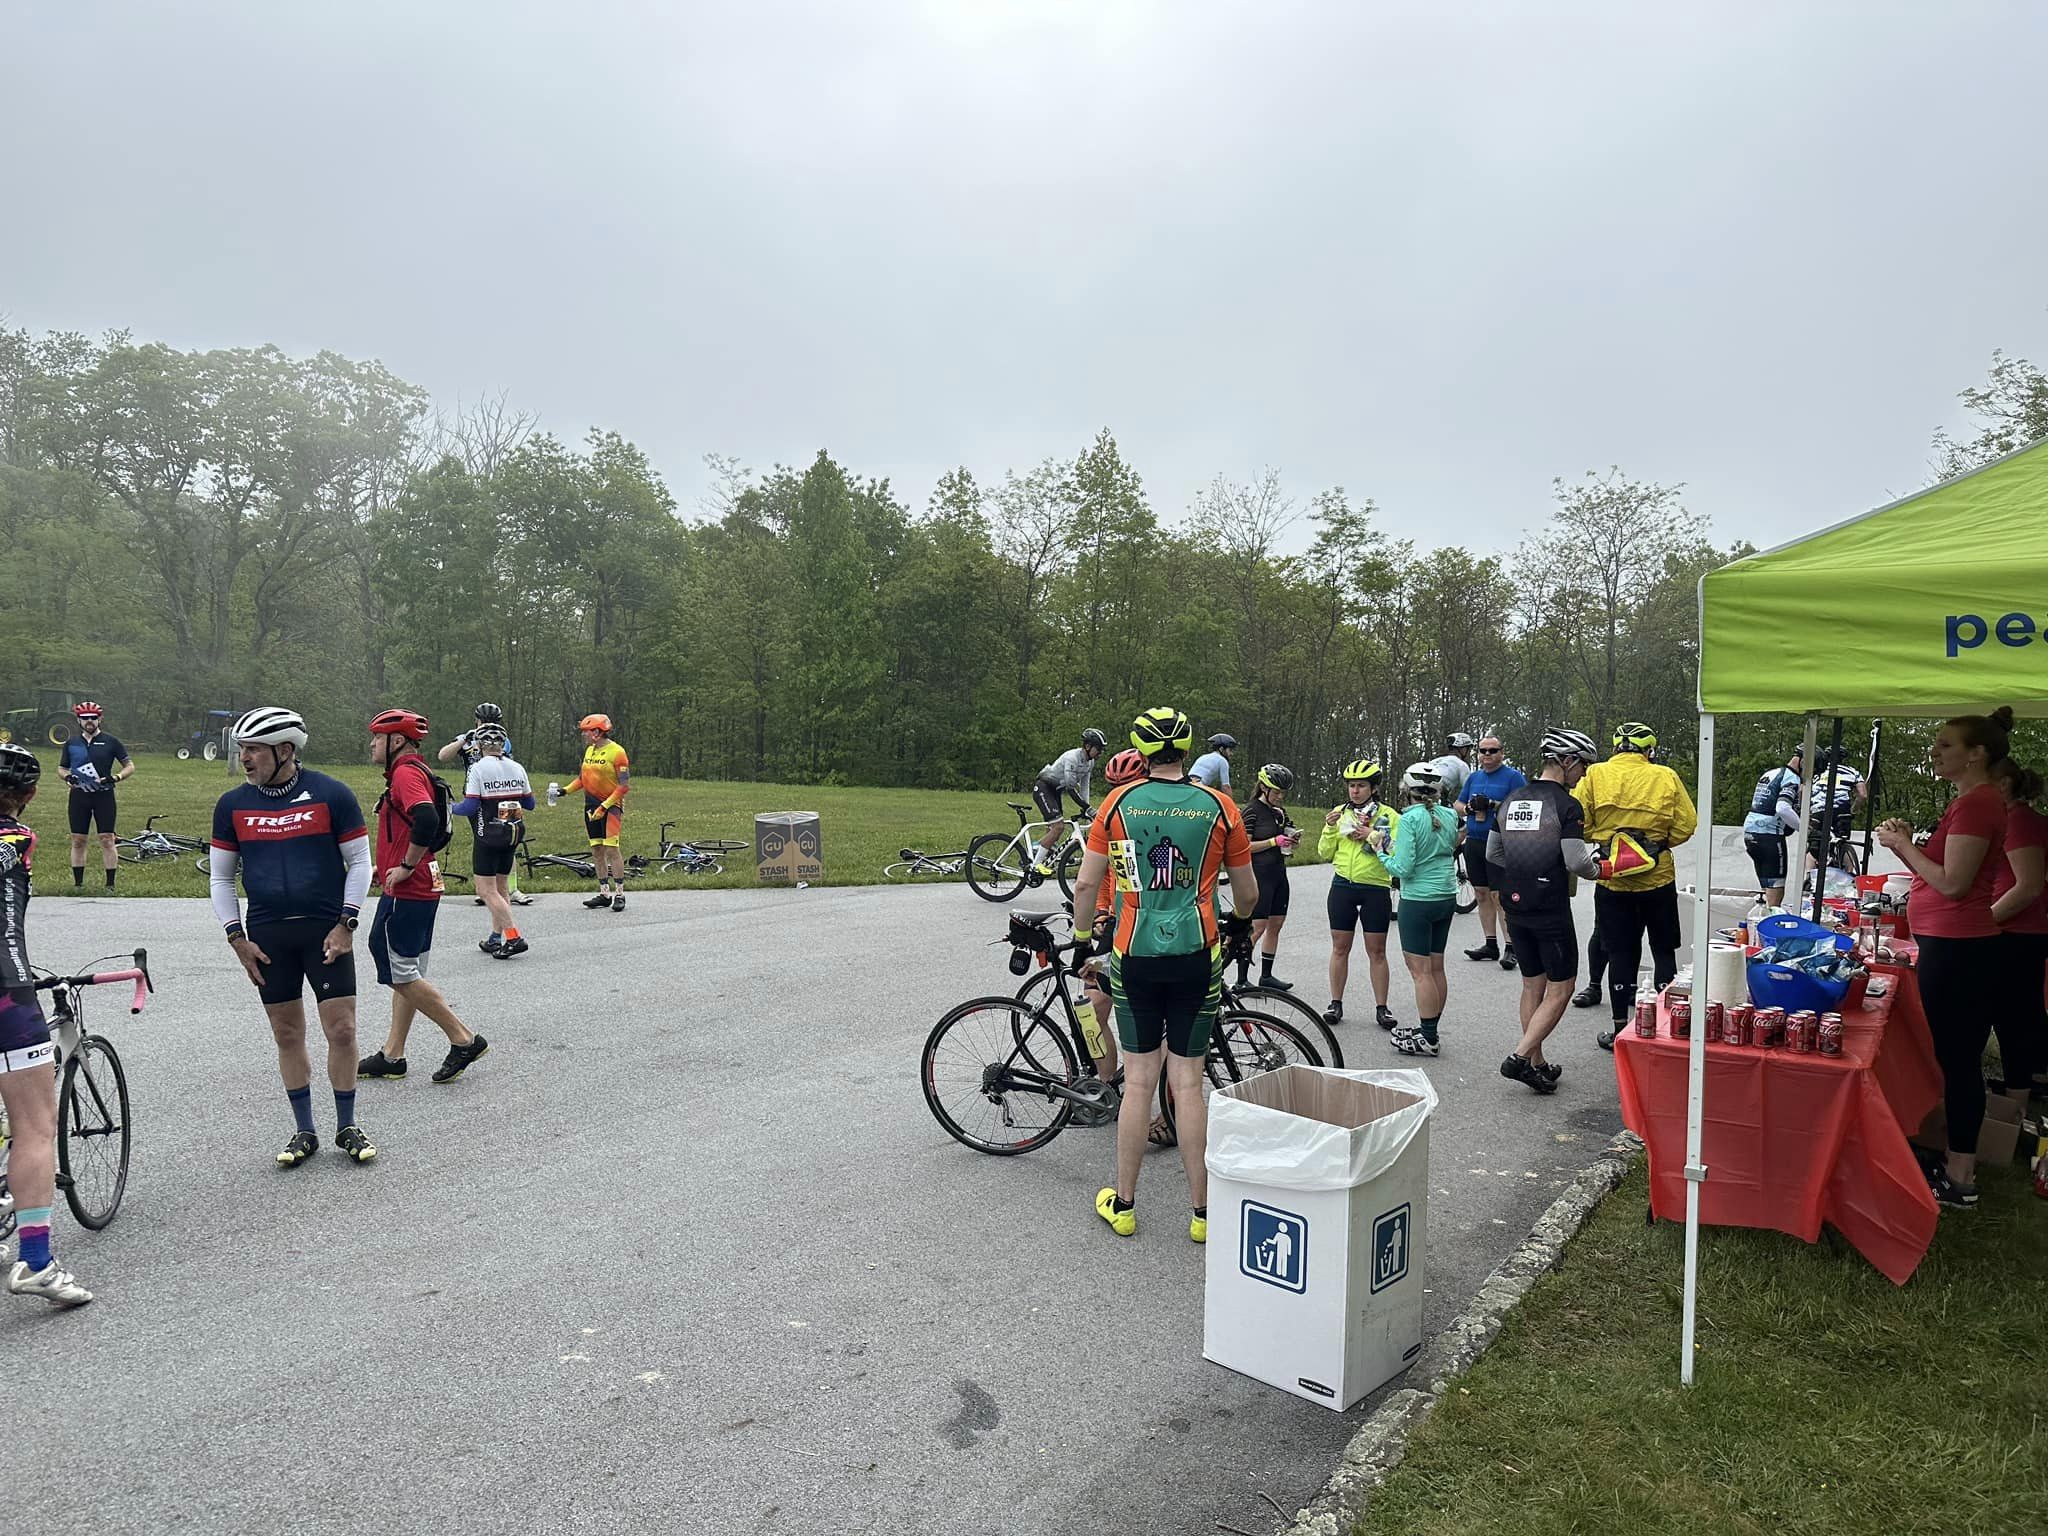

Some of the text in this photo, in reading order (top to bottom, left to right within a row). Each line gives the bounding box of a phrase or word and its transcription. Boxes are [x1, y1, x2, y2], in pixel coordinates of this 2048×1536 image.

[1945, 611, 2048, 658] pe
[243, 810, 315, 827] TREK
[1126, 805, 1212, 819] Squirrel Dodgers
[1514, 811, 1534, 821] 505
[283, 823, 303, 833] BEACH
[764, 841, 782, 852] GU
[800, 840, 815, 850] GU
[760, 865, 789, 876] STASH
[797, 864, 820, 874] STASH
[1113, 854, 1128, 877] 147
[1177, 867, 1194, 880] 811
[5, 877, 16, 902] Ridge
[5, 903, 16, 938] Thunder
